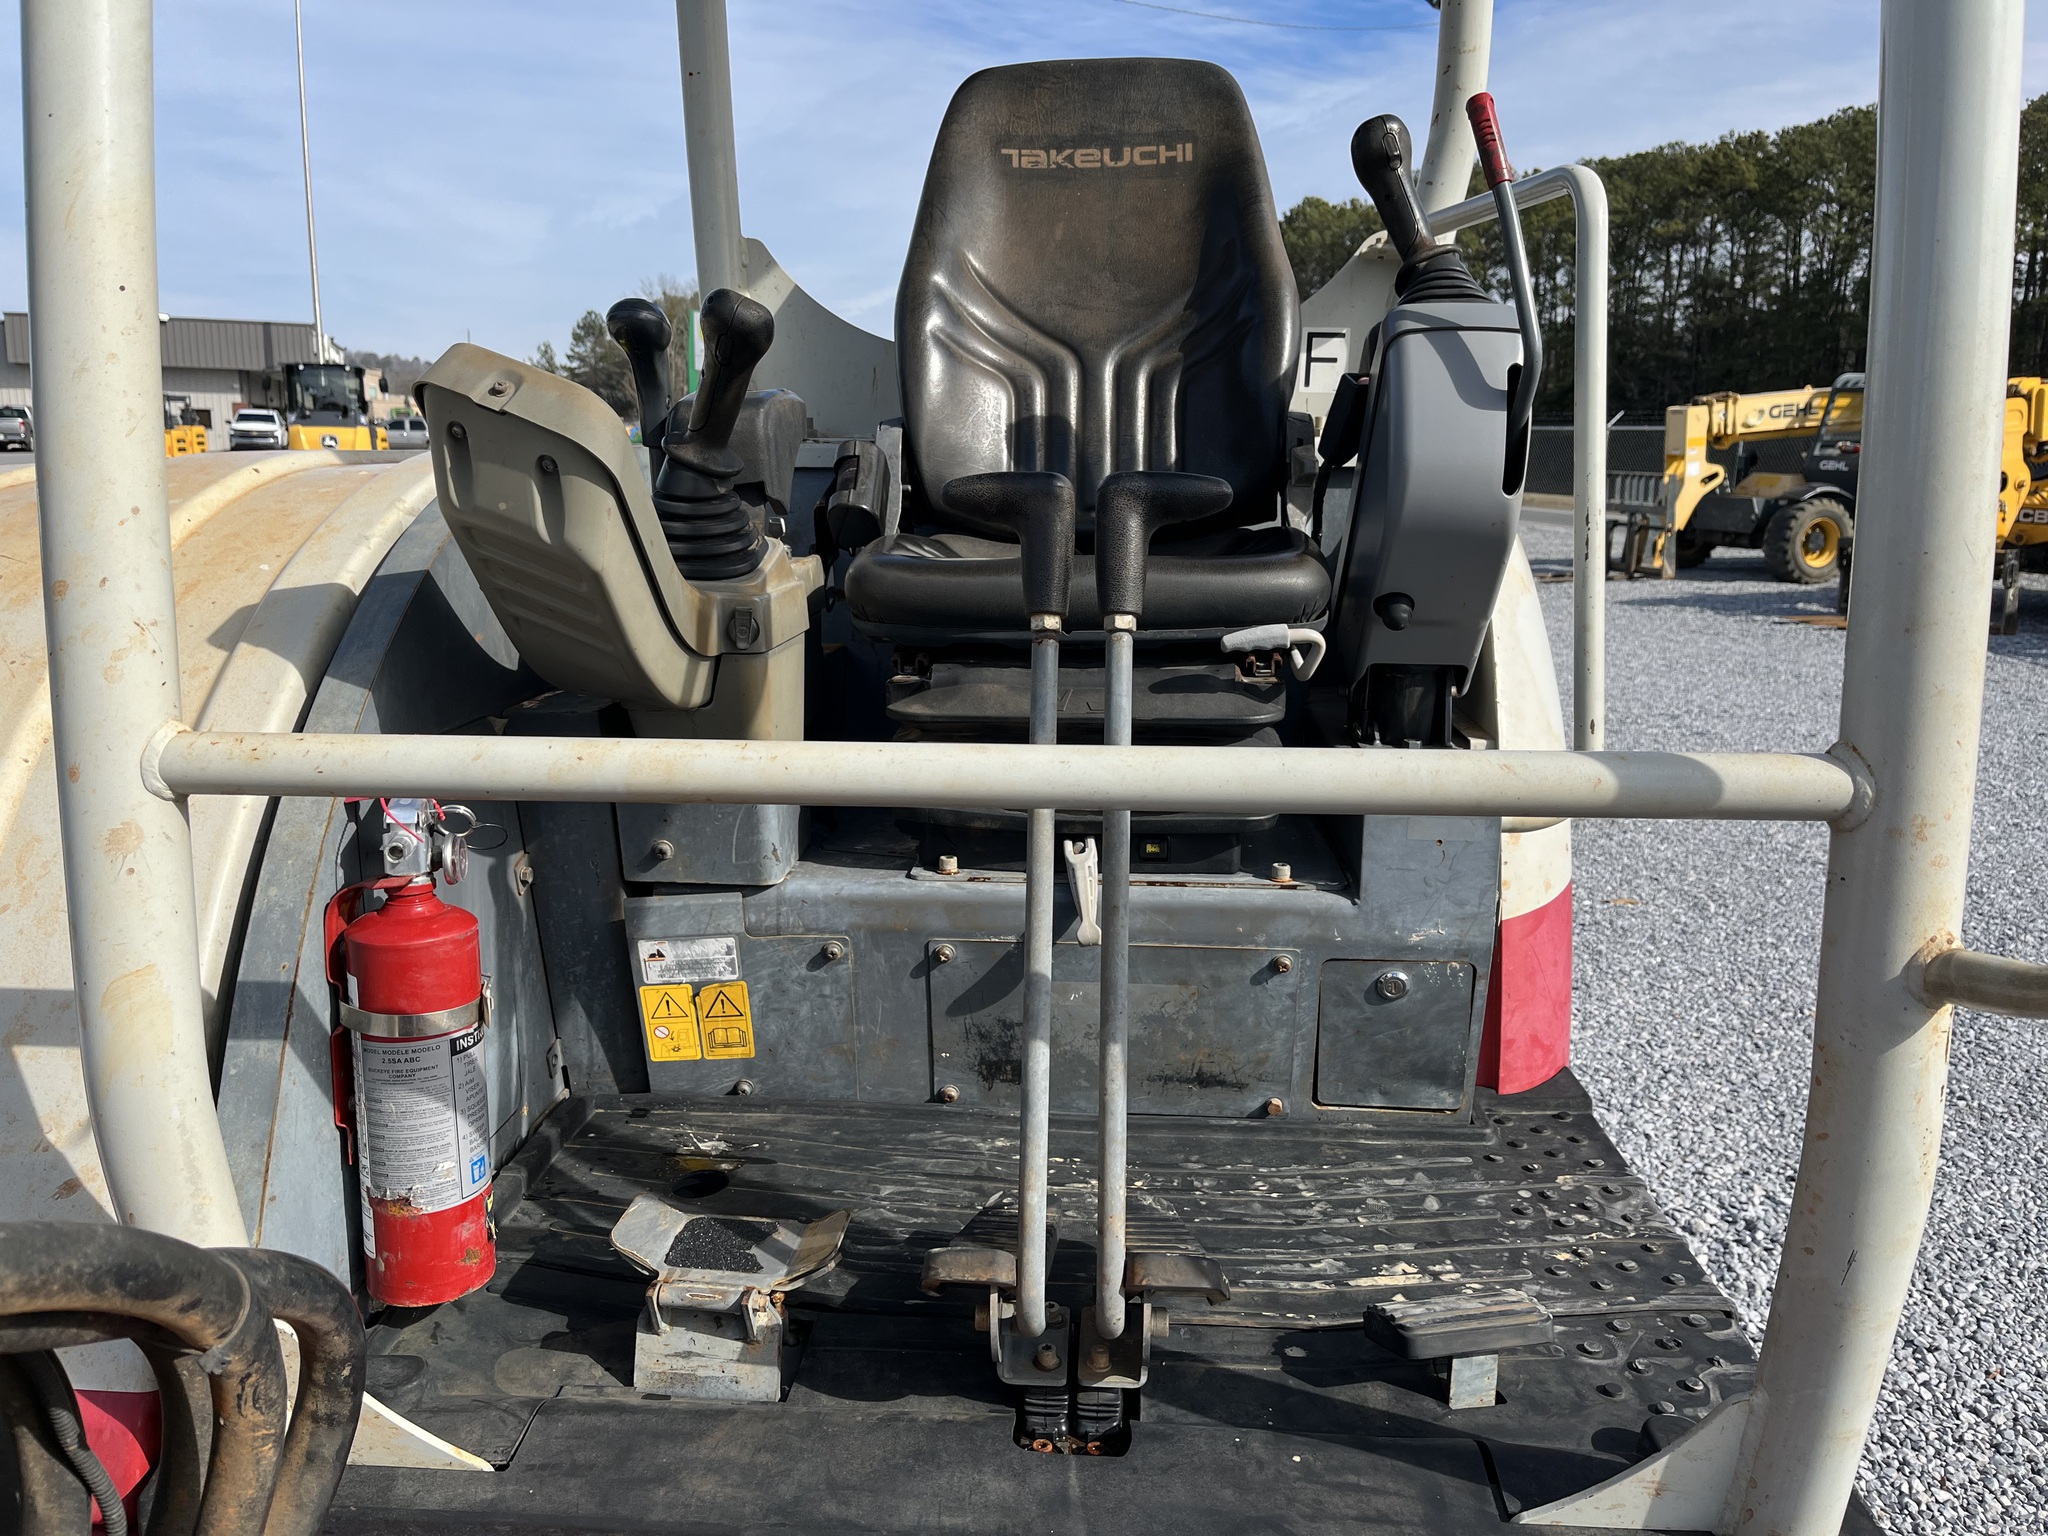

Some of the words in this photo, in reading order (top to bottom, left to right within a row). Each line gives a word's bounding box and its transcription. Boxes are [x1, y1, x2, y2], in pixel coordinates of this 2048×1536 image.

[1001, 143, 1193, 168] TAKEUCHI
[1304, 332, 1346, 388] F
[1769, 402, 1819, 419] GEHL
[1820, 460, 1850, 472] GEHL
[2016, 508, 2048, 523] CB
[411, 1045, 441, 1054] MODELO
[403, 1056, 421, 1064] ABC
[405, 1064, 439, 1073] EQUIPMENT
